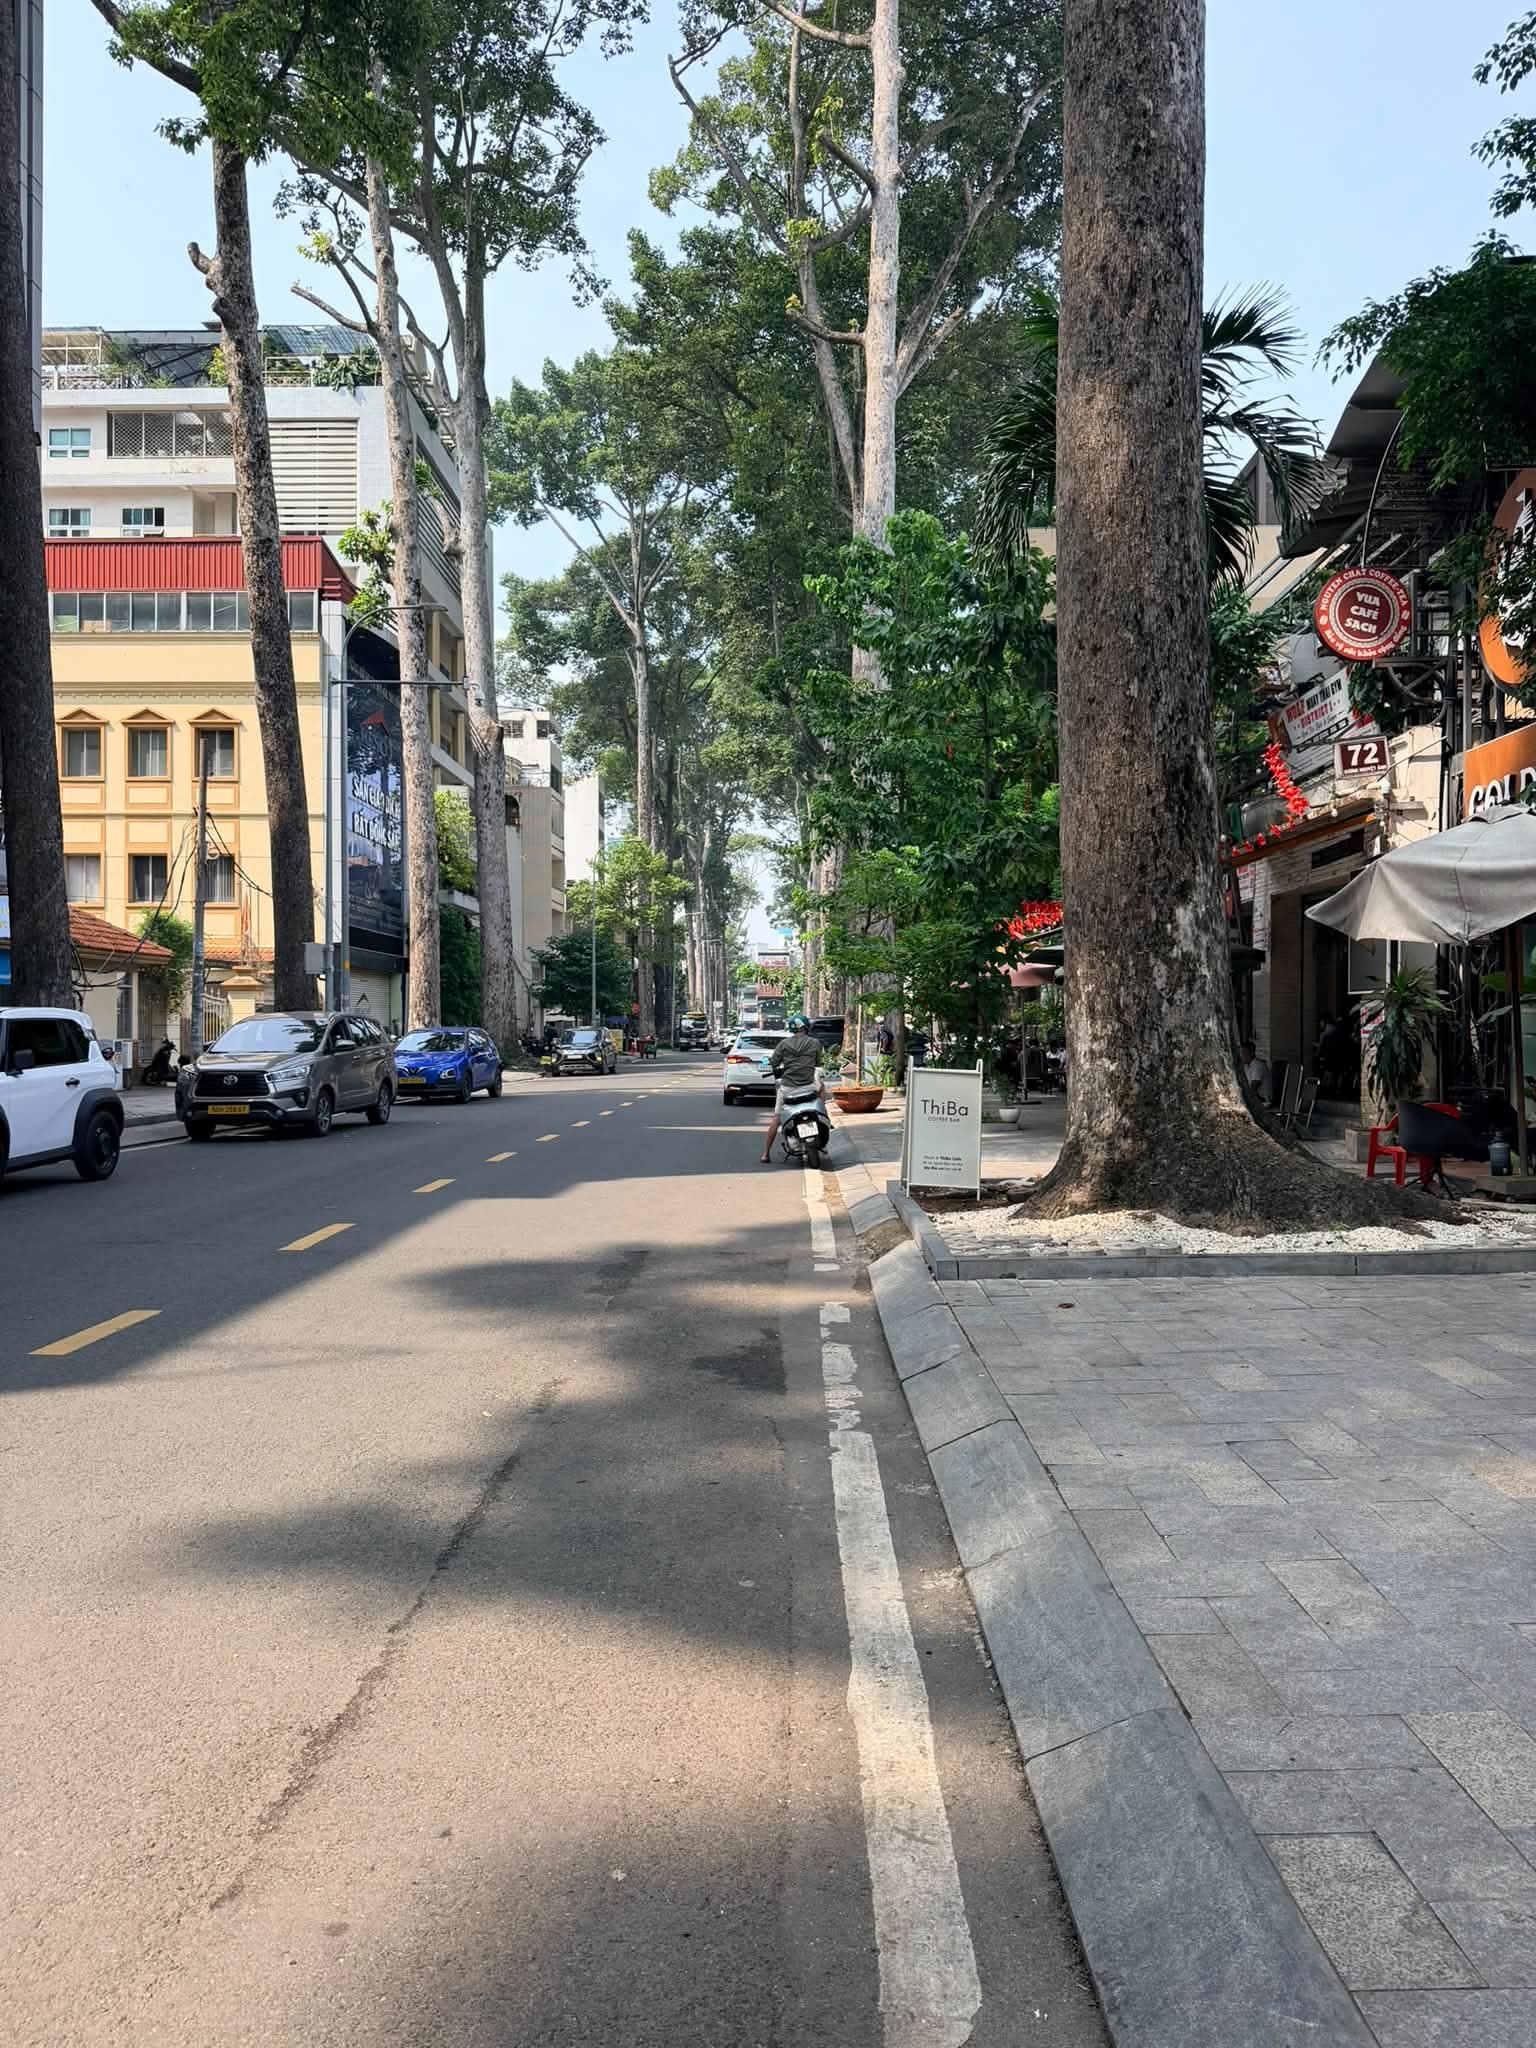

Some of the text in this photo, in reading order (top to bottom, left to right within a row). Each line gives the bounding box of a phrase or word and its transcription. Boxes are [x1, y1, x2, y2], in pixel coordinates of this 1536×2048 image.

[1356, 591, 1380, 607] VUA
[1347, 742, 1379, 766] 72
[920, 1098, 969, 1117] ThiBa
